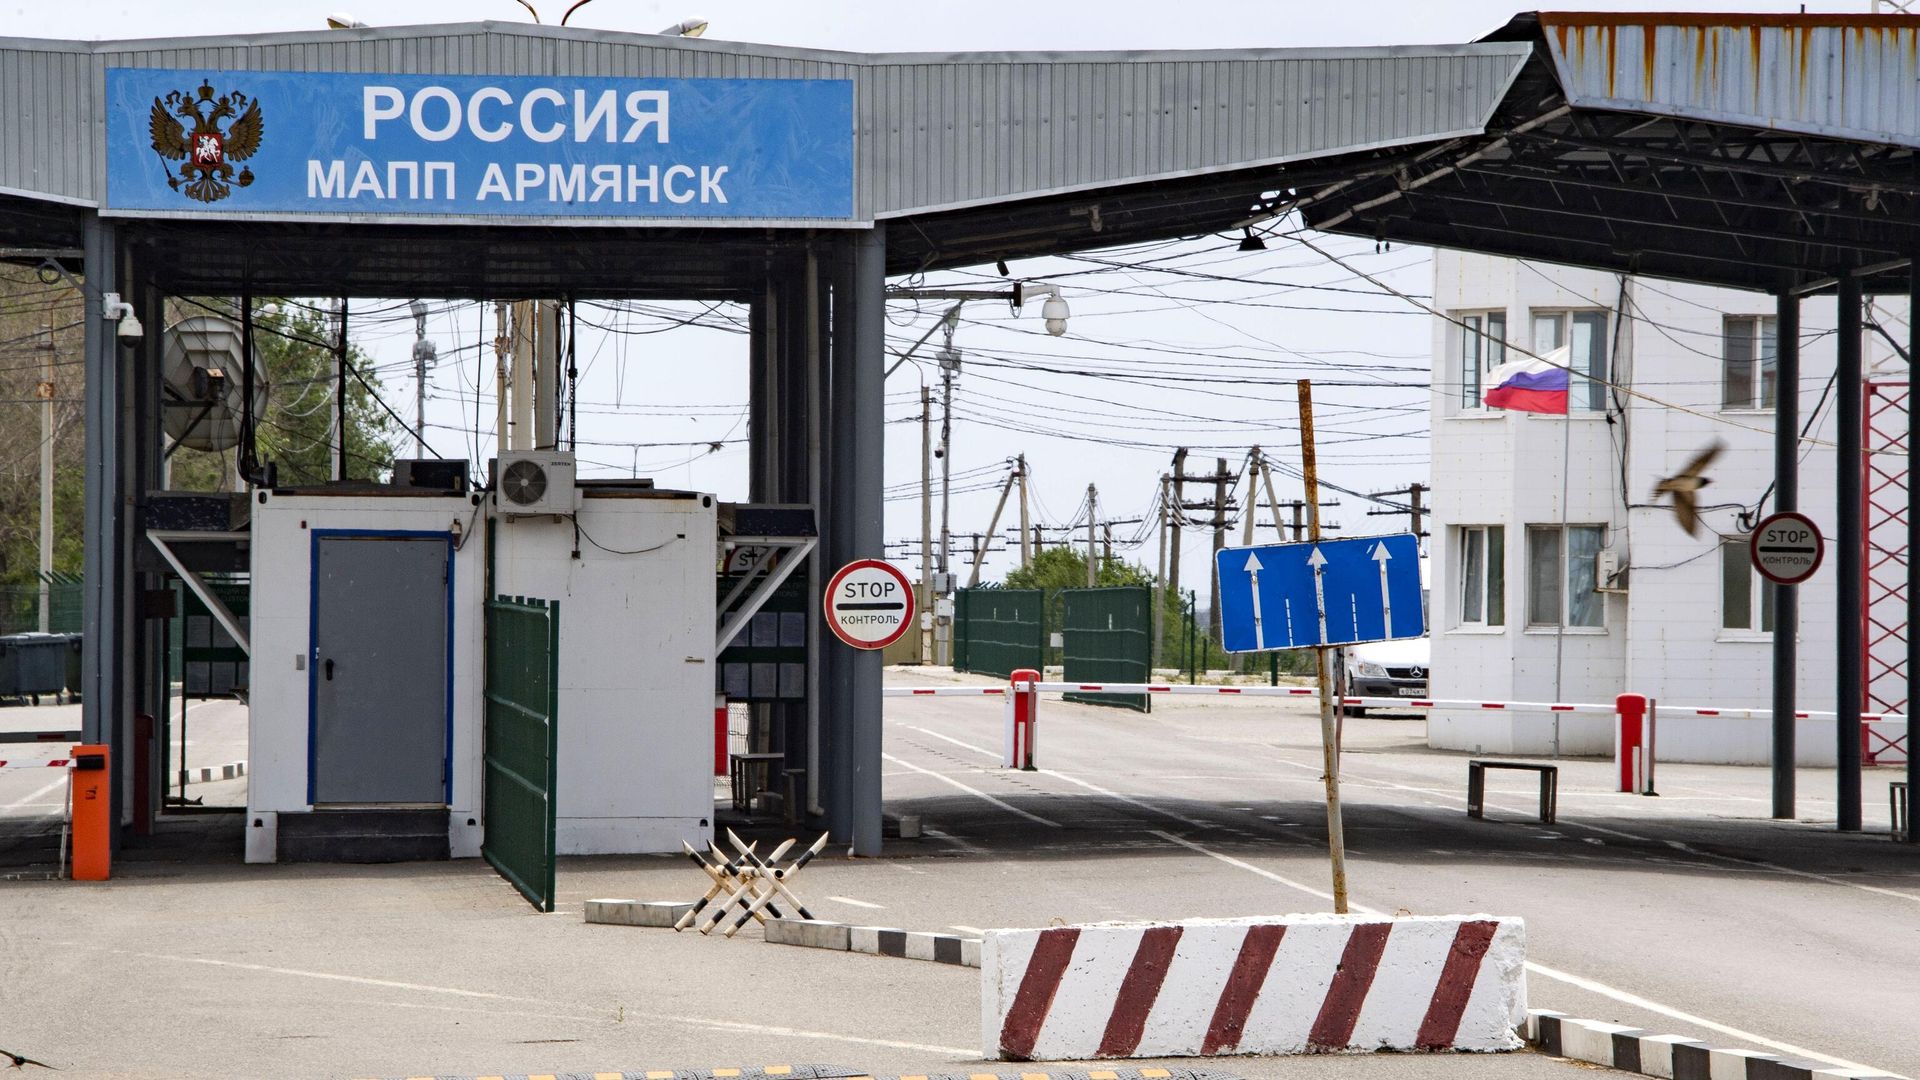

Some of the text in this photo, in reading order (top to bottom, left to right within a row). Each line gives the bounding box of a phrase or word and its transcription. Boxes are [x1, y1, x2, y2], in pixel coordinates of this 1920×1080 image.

[364, 86, 669, 143] РОССИЯ
[307, 160, 728, 204] МАПП АРМЯНСК
[1766, 529, 1809, 543] STOP
[1762, 555, 1812, 566] КОНТРОЛЬ
[844, 582, 896, 599] STOP
[840, 615, 900, 625] КОНТРОЛЬ
